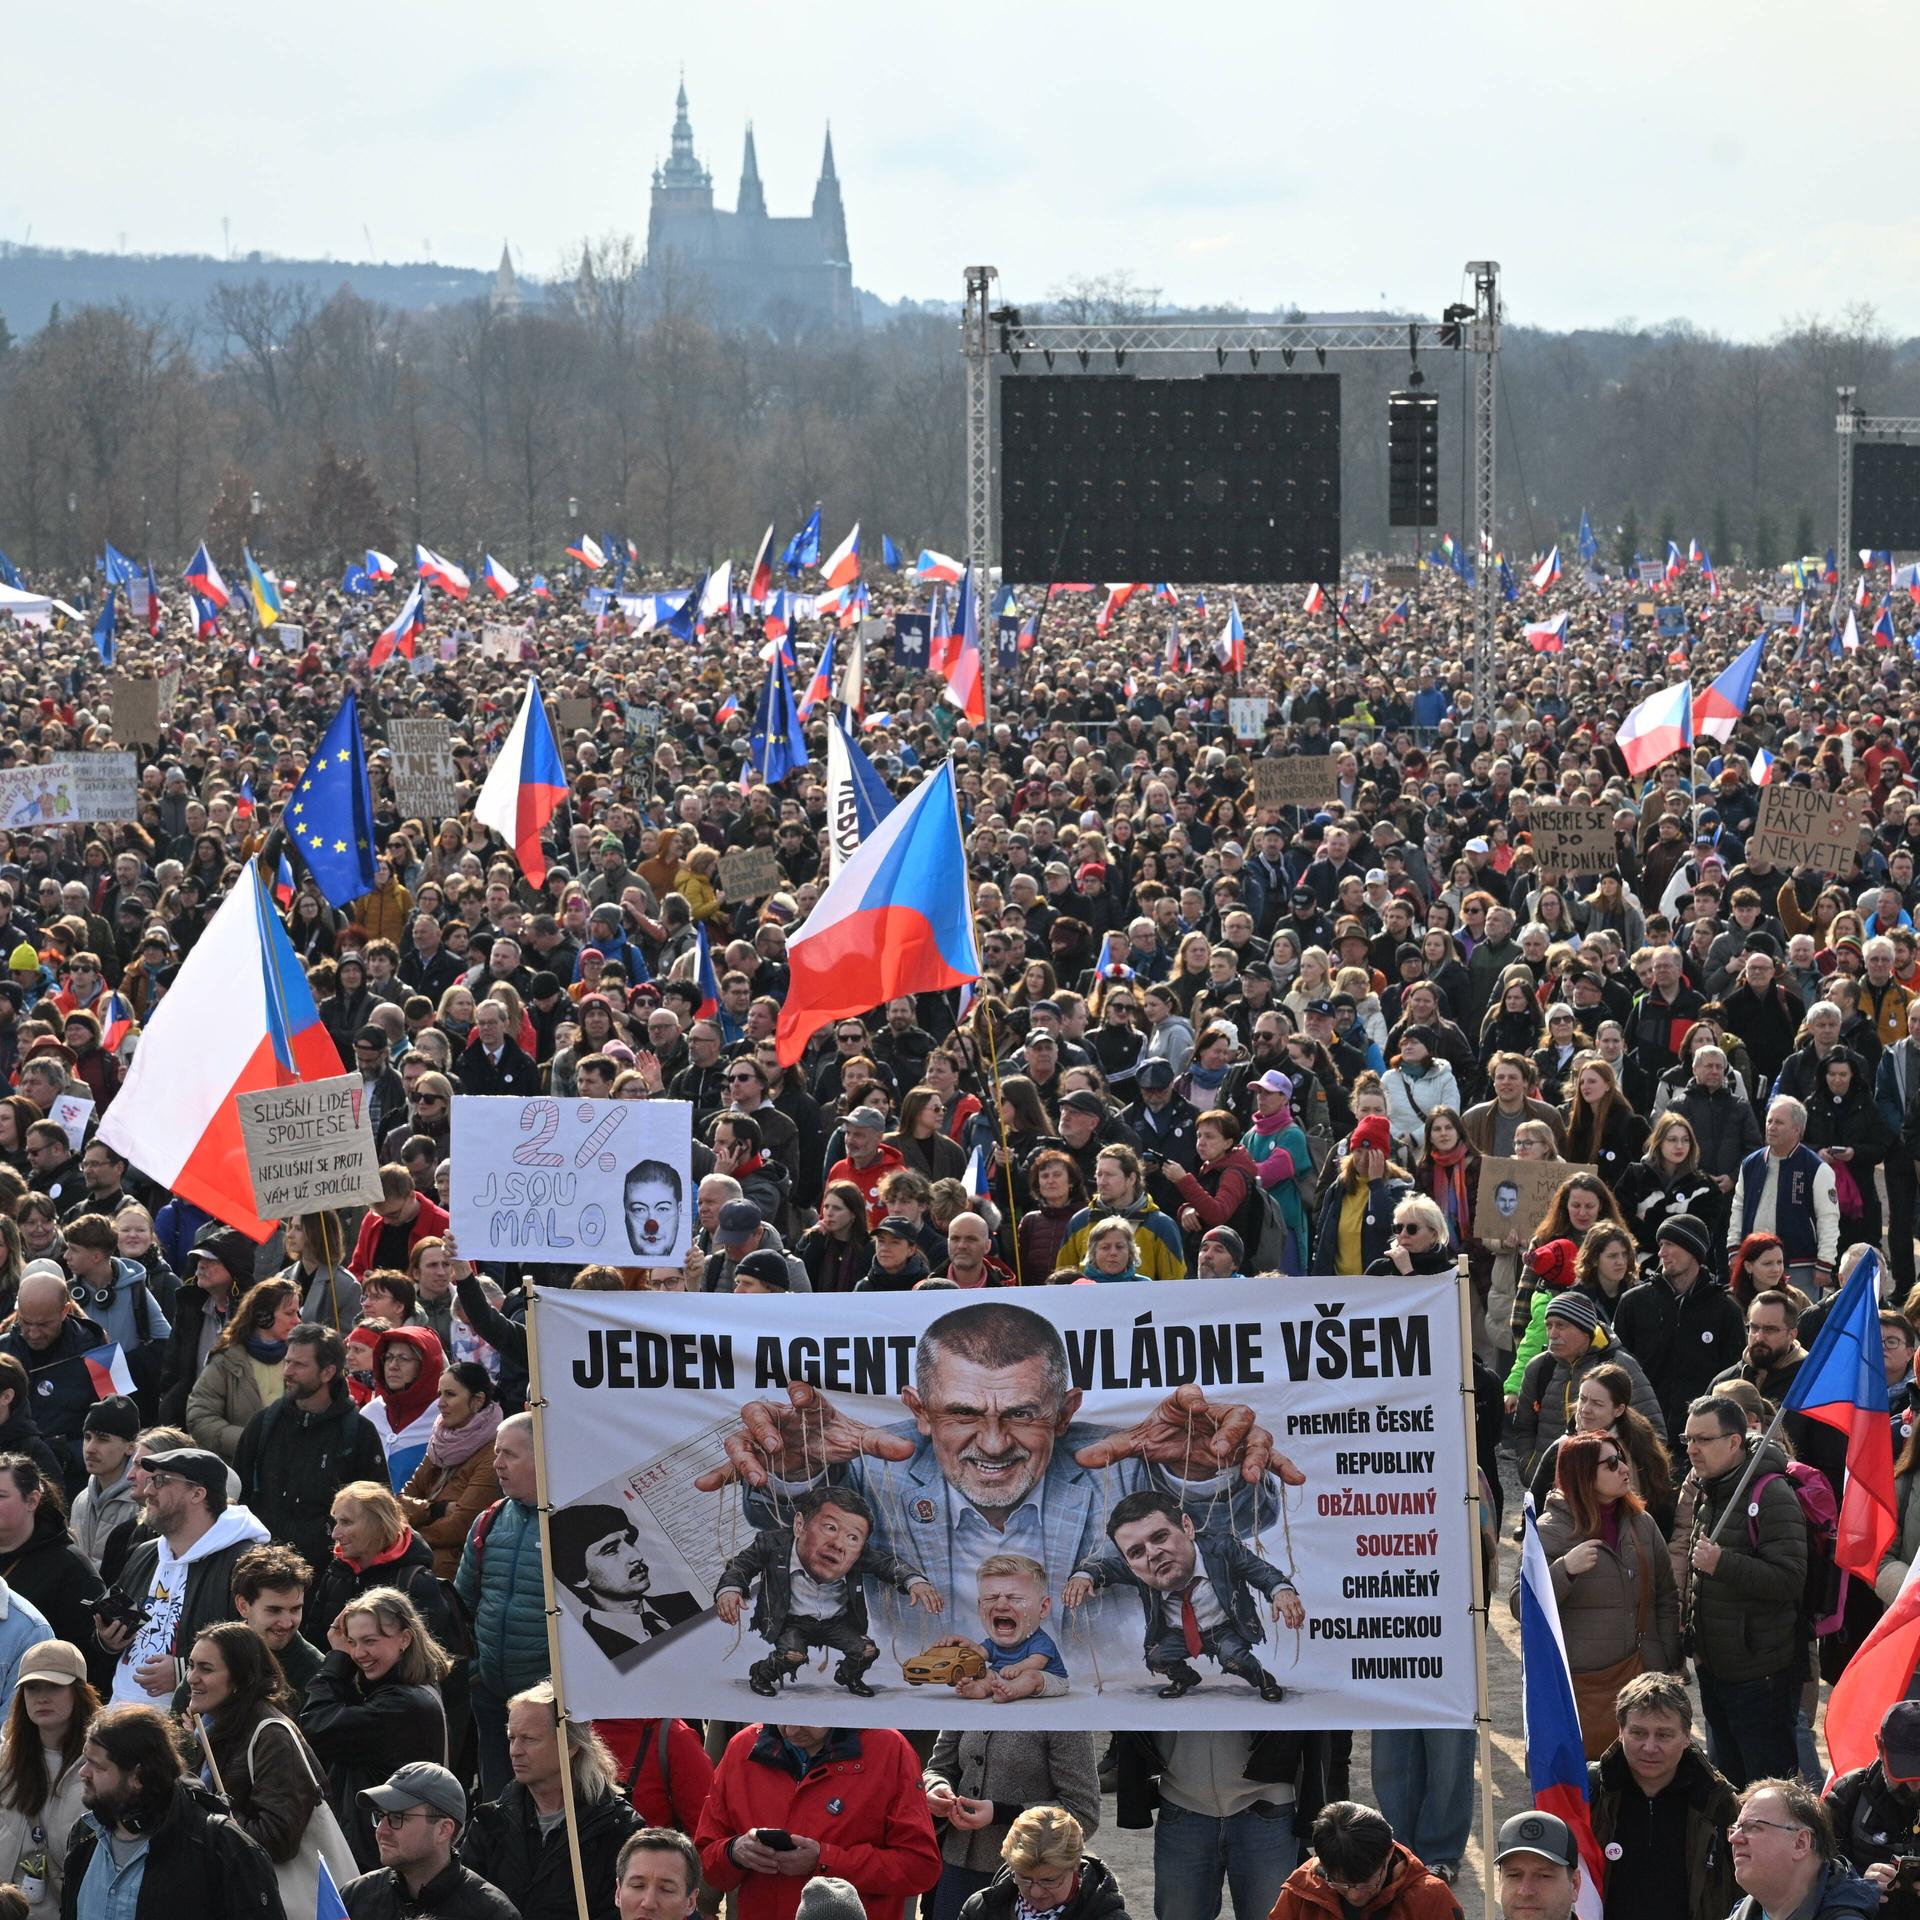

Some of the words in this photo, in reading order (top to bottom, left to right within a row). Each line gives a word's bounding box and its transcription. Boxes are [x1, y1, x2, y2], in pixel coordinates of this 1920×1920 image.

[1000, 629, 1017, 652] P3
[0, 768, 37, 784] RACKY
[41, 763, 71, 779] PRYČ
[1767, 786, 1833, 814] BETON
[1529, 809, 1583, 831] NESERTE
[1586, 811, 1606, 830] SE
[1764, 807, 1817, 835] FAKT
[1557, 833, 1583, 845] DO
[1759, 834, 1852, 874] NEKVETE
[253, 1093, 314, 1124] SLUŠNÍ
[512, 1099, 629, 1173] 2%
[258, 1155, 317, 1183] NESLUŠNÍ
[315, 1157, 330, 1173] SE
[333, 1152, 363, 1171] PROTI
[263, 1186, 290, 1205] VÁM
[294, 1181, 310, 1200] UŽ
[572, 1329, 736, 1390] JEDEN
[754, 1335, 917, 1396] AGENT
[1063, 1310, 1265, 1391] VLÁDNE
[1280, 1302, 1432, 1382] VŠEM
[1286, 1407, 1371, 1436] PREMIÉR
[1375, 1404, 1435, 1433] ČESKÉ
[1335, 1451, 1436, 1475] REPUBLIKY
[1317, 1487, 1438, 1517] OBŽALOVANÝ
[1356, 1528, 1439, 1557] SOUZENÝ
[1342, 1568, 1441, 1599] CHRÁNĚNÝ
[1309, 1615, 1443, 1640] POSLANECKOU
[1351, 1656, 1444, 1680] IMUNITOU
